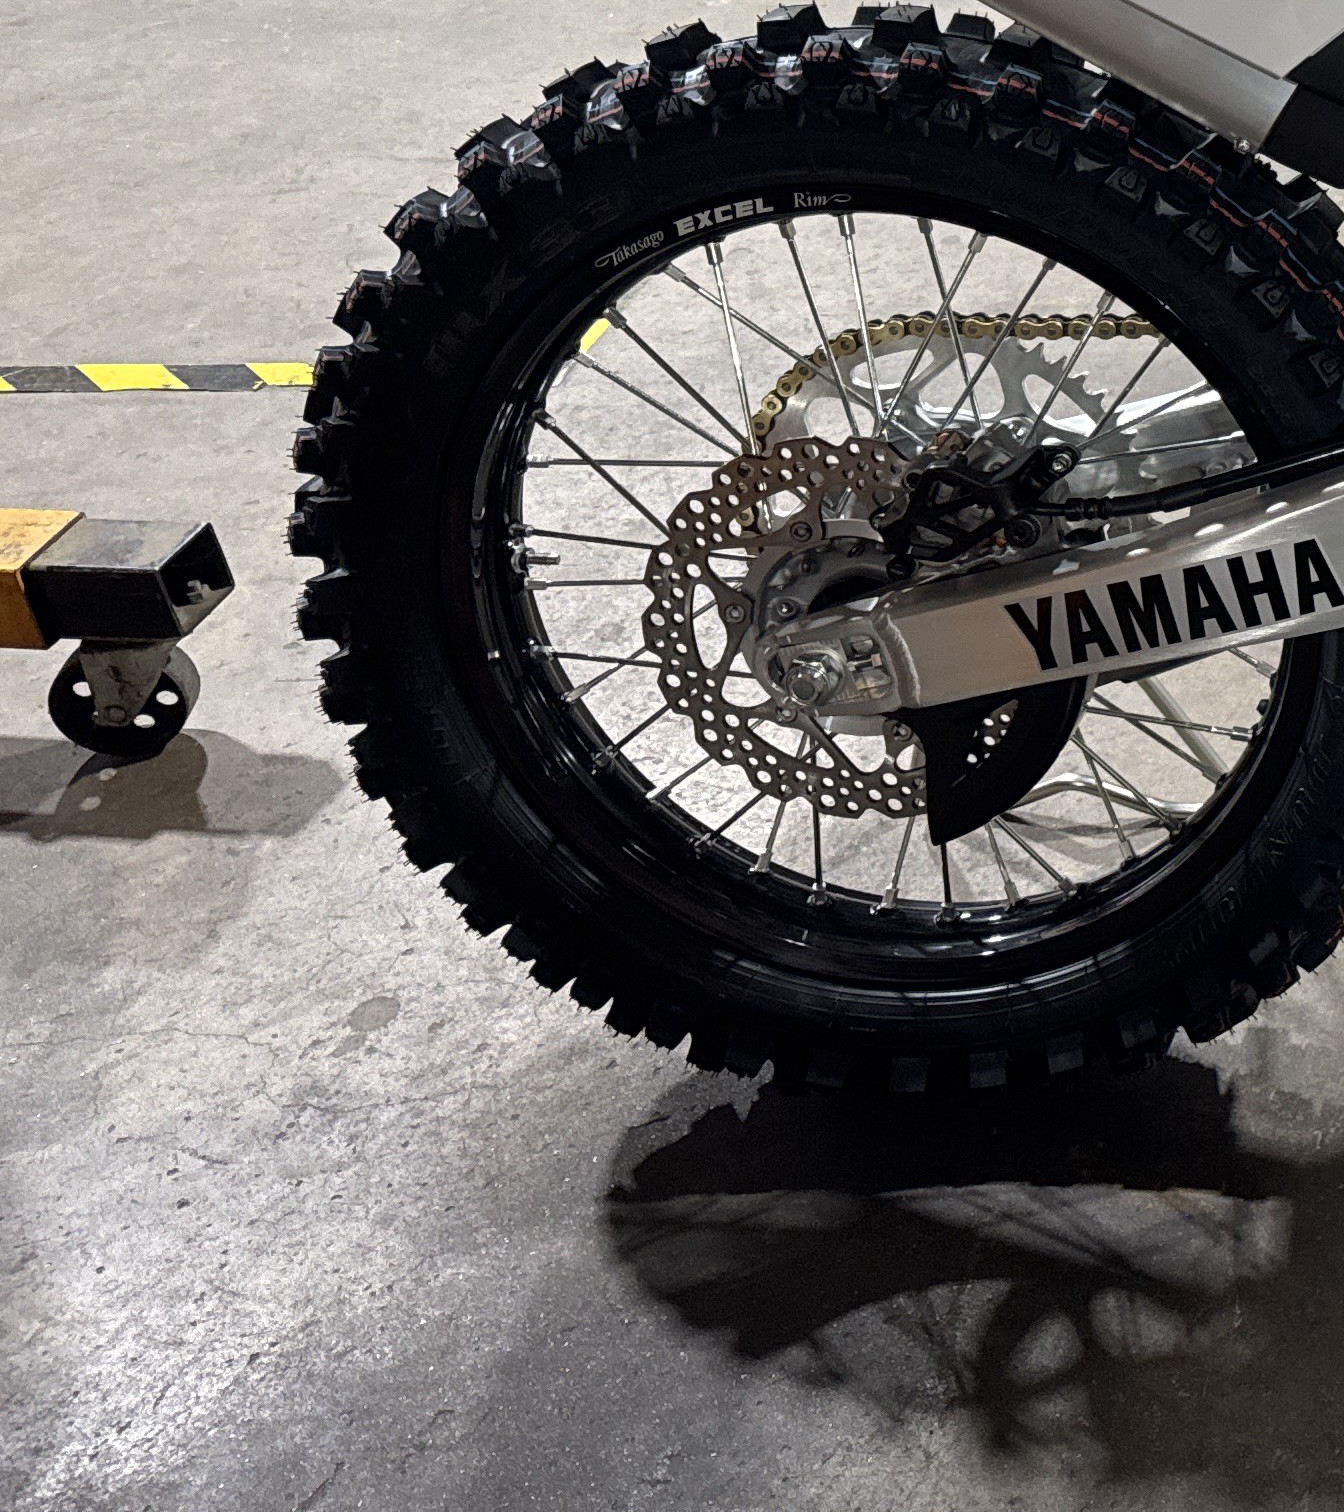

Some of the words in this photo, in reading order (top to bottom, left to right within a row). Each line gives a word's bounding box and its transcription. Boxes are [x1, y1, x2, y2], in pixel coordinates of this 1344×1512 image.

[594, 230, 665, 269] Takasago
[673, 197, 775, 237] EXCEL
[793, 191, 852, 209] Rim
